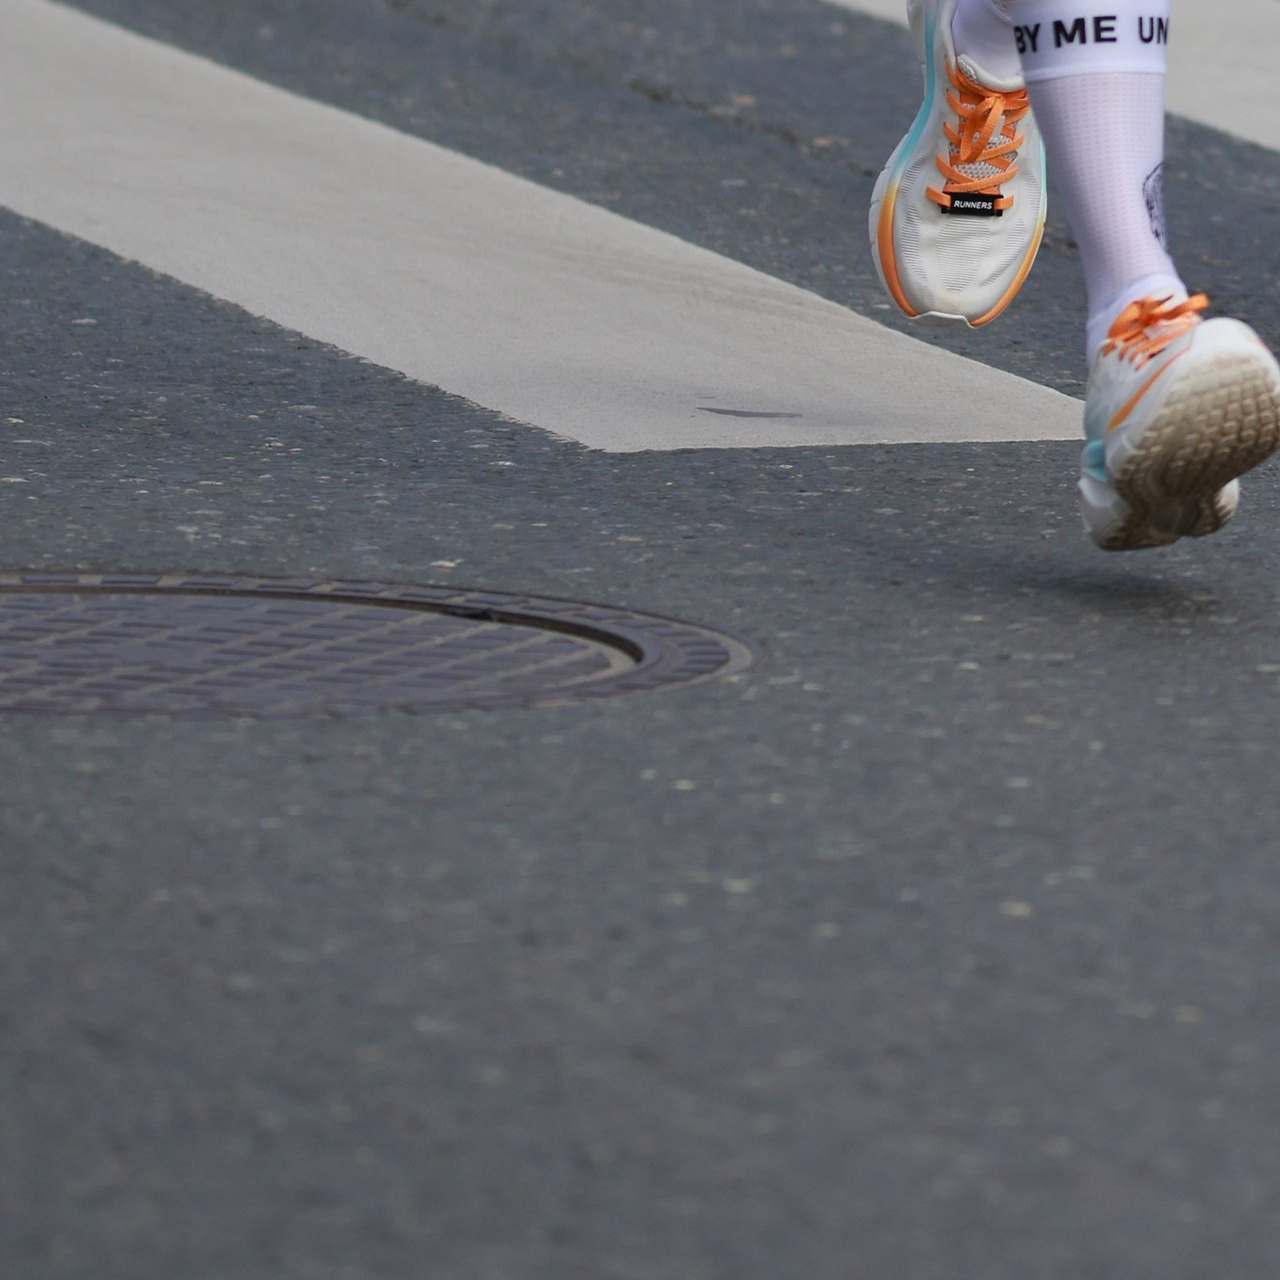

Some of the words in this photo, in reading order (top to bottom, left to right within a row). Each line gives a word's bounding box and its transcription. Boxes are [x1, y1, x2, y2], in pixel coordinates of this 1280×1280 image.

[1013, 23, 1041, 54] BY
[1053, 15, 1118, 49] ME
[953, 200, 993, 210] RUNNERS
